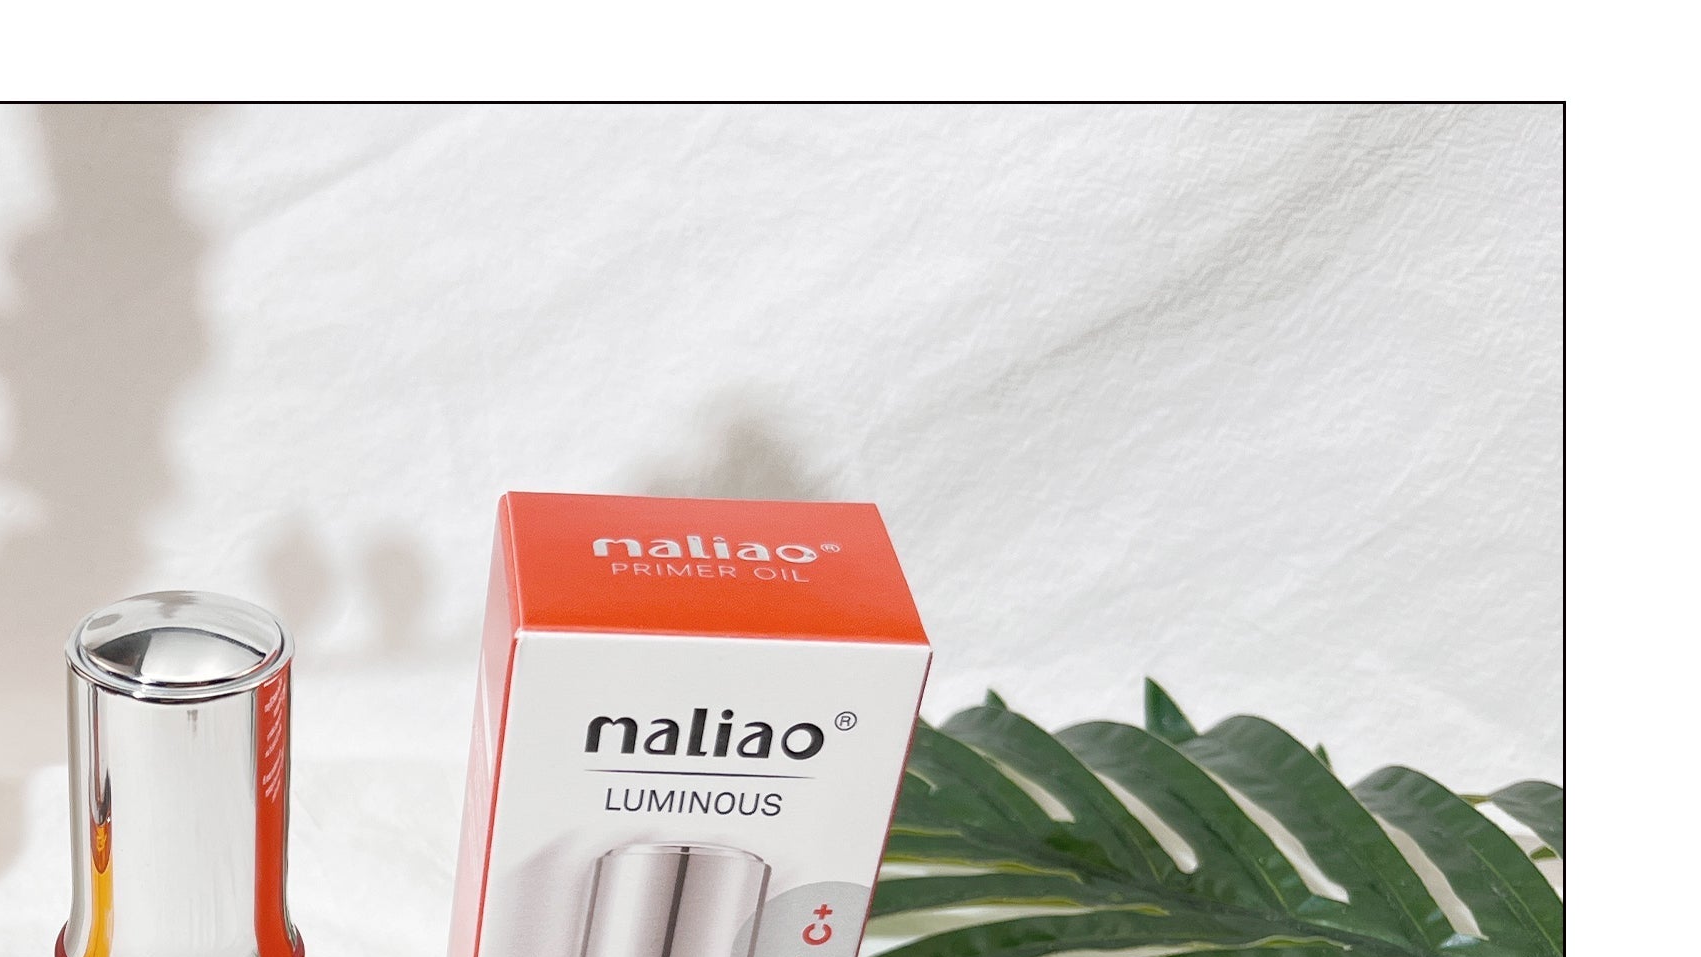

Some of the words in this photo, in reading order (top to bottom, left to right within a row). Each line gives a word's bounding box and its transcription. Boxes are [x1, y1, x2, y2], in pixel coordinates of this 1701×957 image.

[592, 535, 817, 563] maliao
[611, 563, 736, 579] PRIMER
[753, 567, 810, 583] OIL
[584, 708, 825, 760] maliao
[605, 788, 783, 817] LUMINOUS
